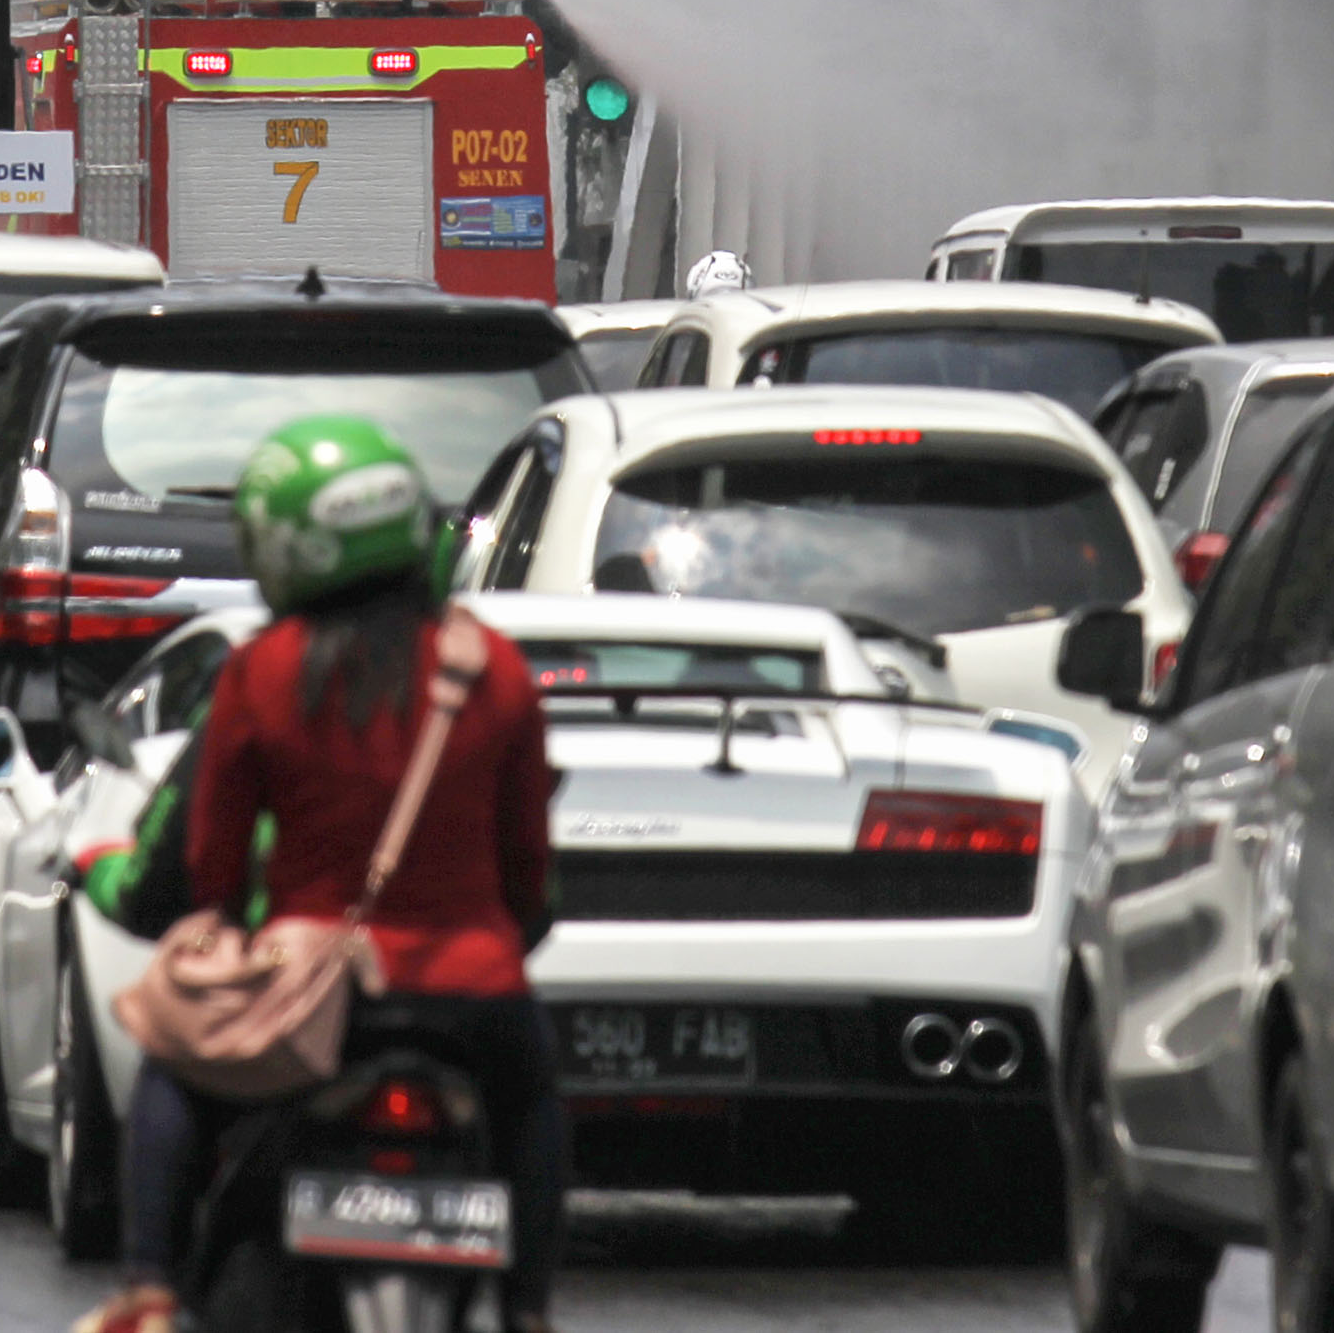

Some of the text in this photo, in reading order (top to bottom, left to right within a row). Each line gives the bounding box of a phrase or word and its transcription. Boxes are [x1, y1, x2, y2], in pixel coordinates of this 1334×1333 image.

[266, 118, 328, 148] SEKTOR
[452, 129, 528, 164] P07-02
[273, 161, 319, 223] 7
[458, 169, 523, 187] SENEN
